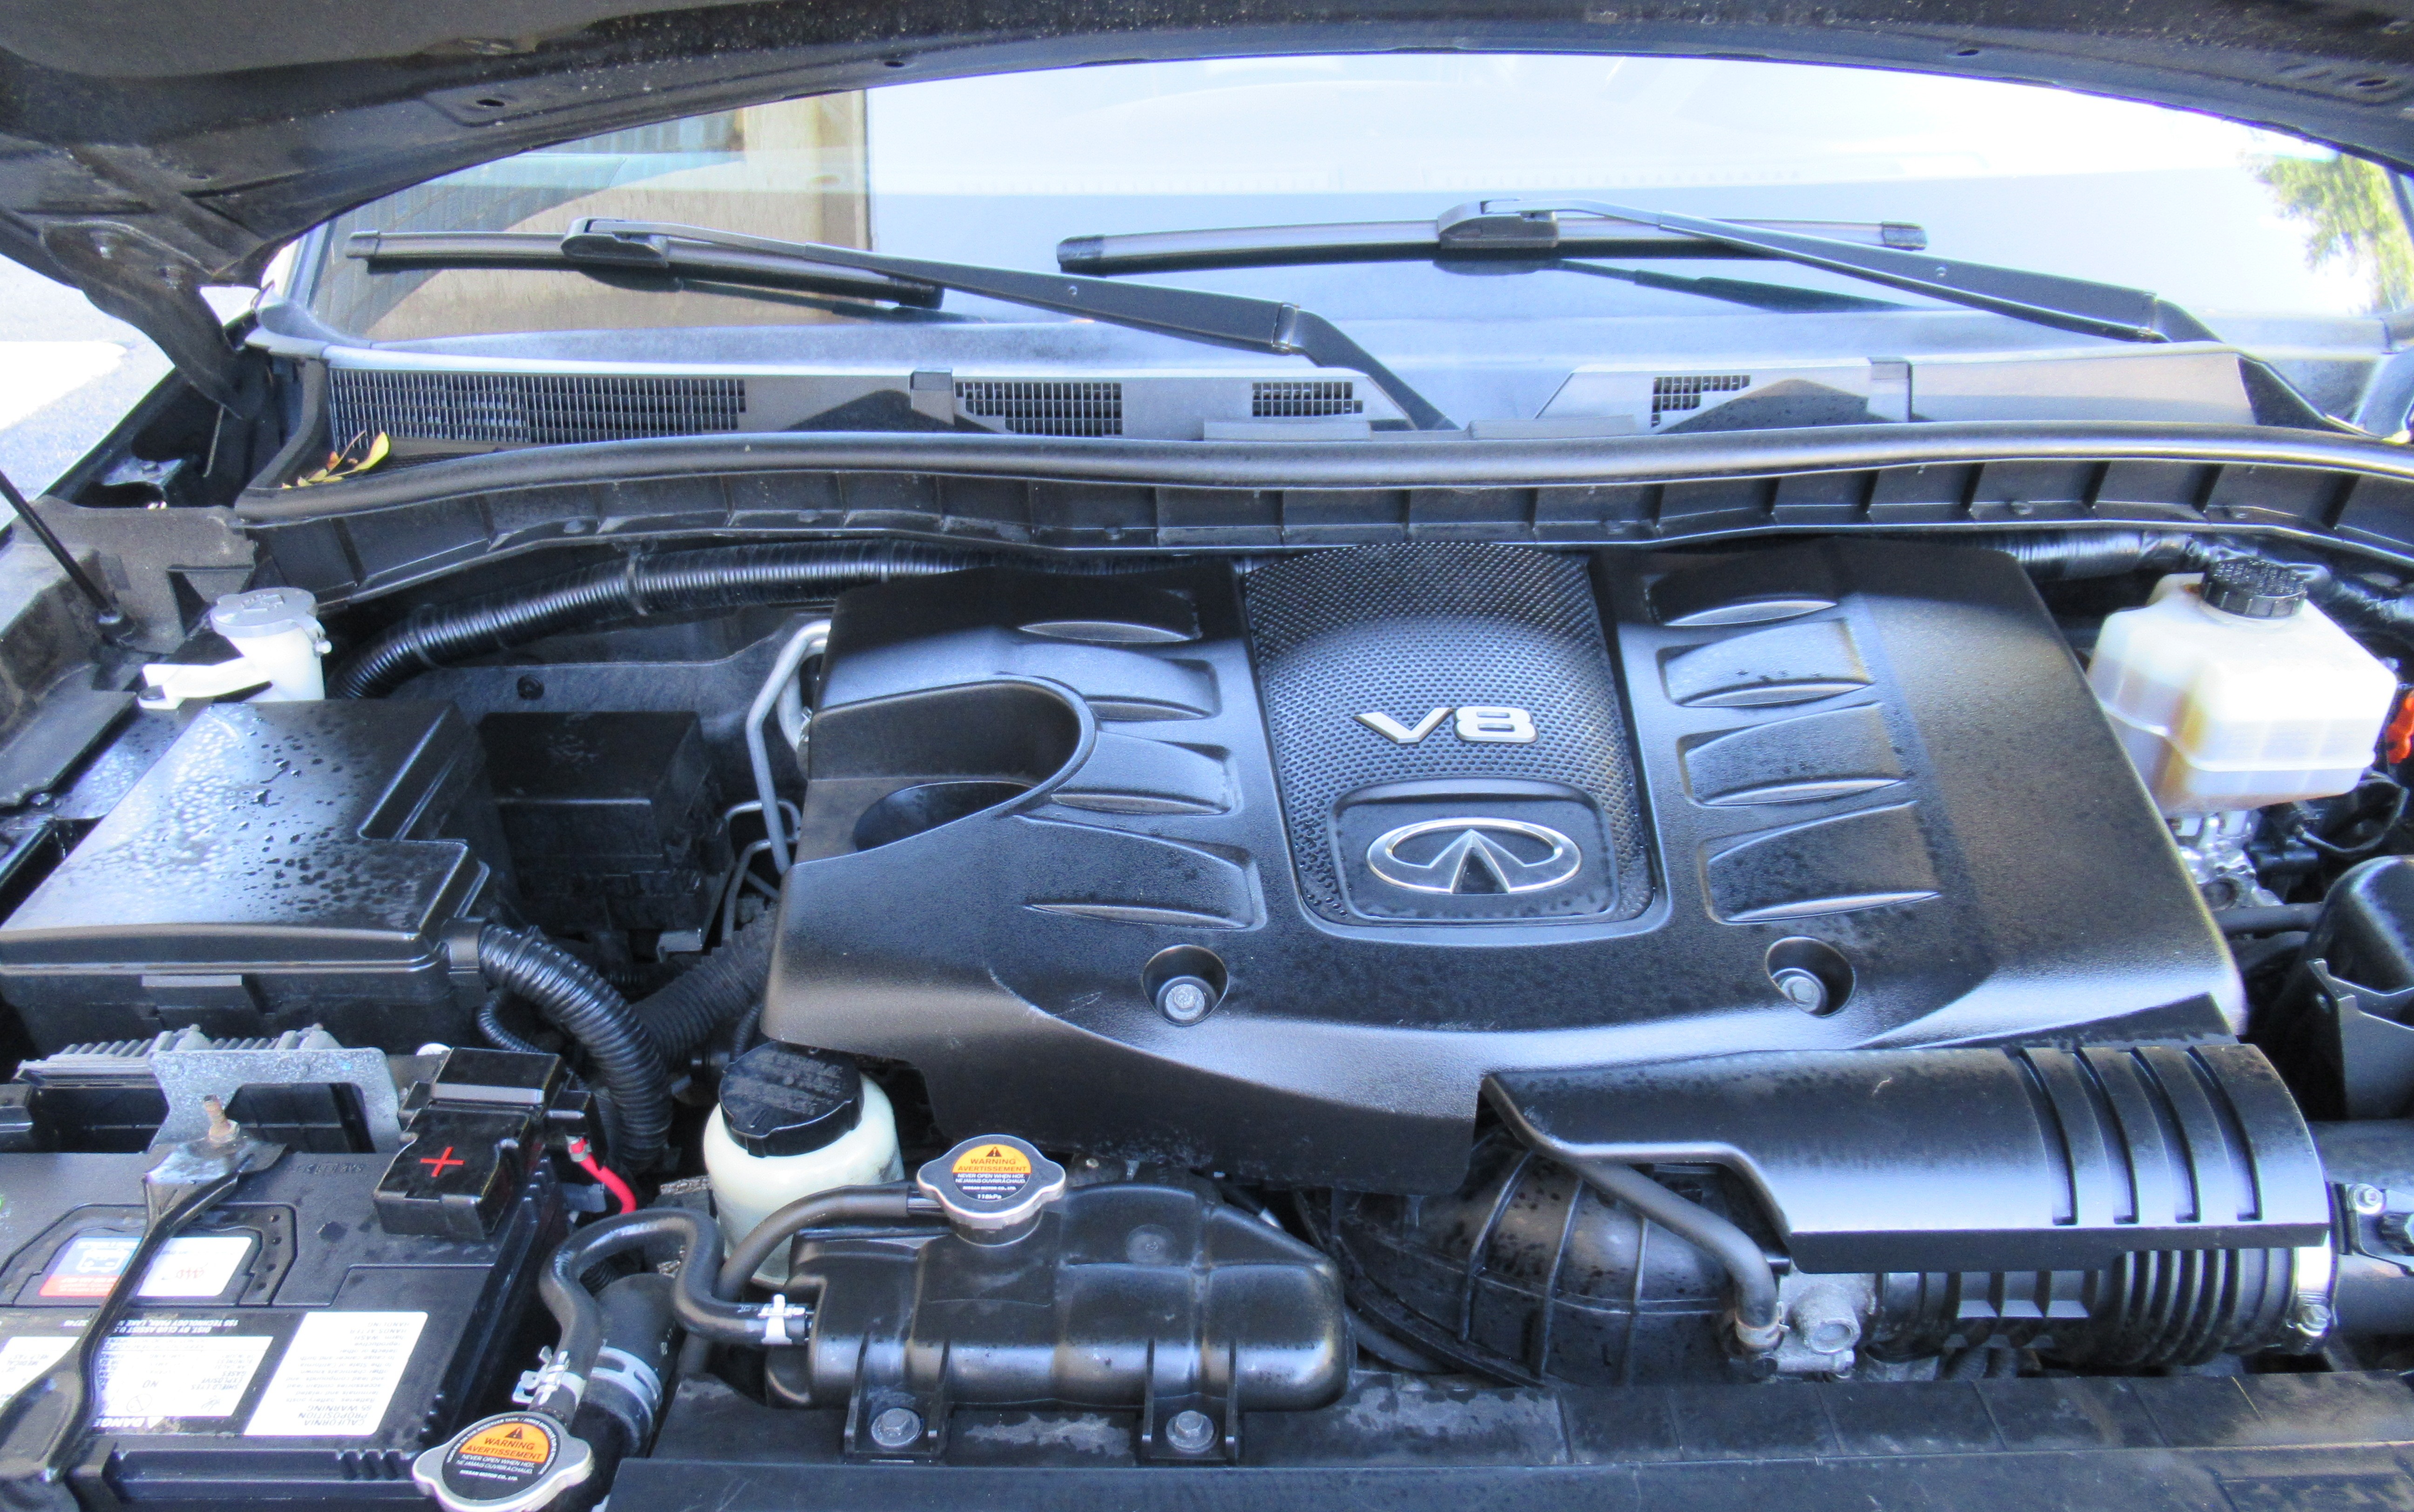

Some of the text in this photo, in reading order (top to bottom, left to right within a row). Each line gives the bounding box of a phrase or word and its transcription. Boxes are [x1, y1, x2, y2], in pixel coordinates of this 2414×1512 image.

[1353, 705, 1540, 744] V8
[142, 1380, 159, 1388] NO
[93, 1417, 145, 1428] DANGE
[484, 1437, 535, 1450] WARNING
[466, 1445, 543, 1460] AVERTISSEMENT
